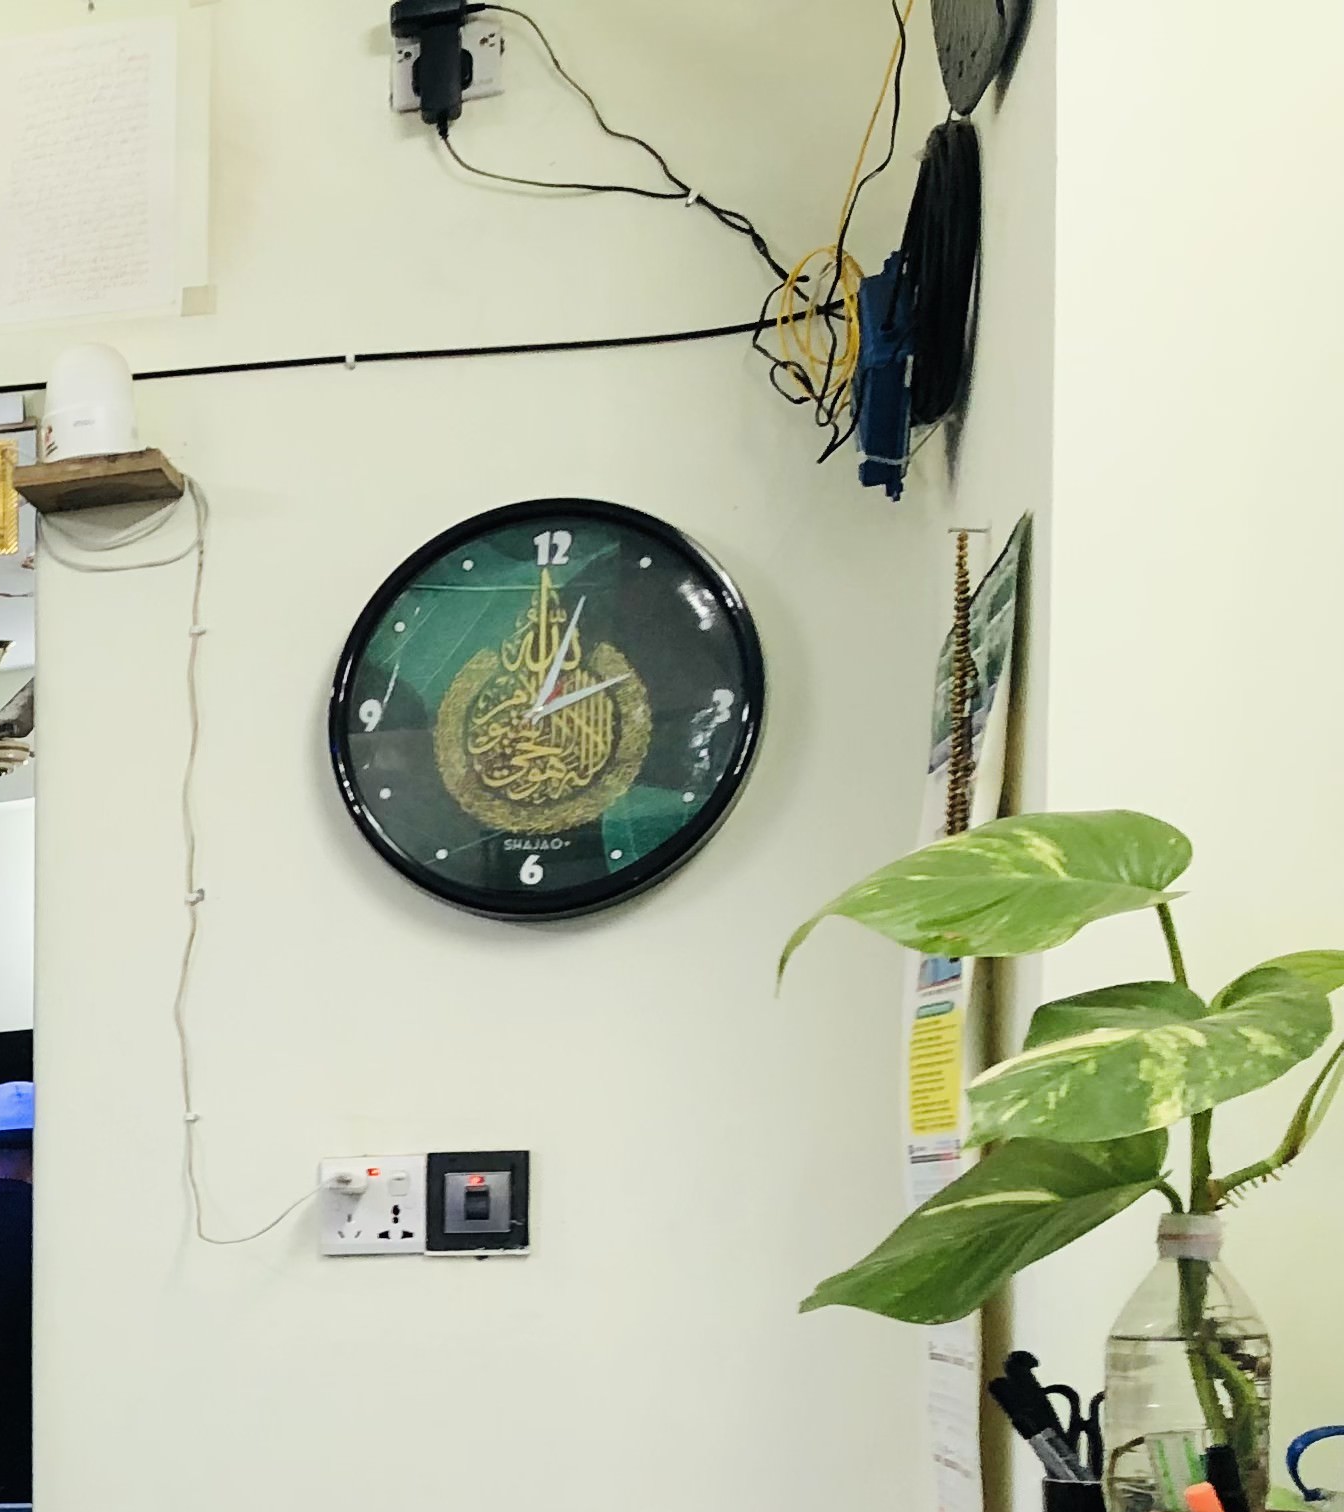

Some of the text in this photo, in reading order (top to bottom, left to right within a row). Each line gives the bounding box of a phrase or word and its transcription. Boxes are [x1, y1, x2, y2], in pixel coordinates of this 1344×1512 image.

[533, 530, 572, 566] 12
[358, 698, 383, 732] 9
[519, 854, 544, 885] 6
